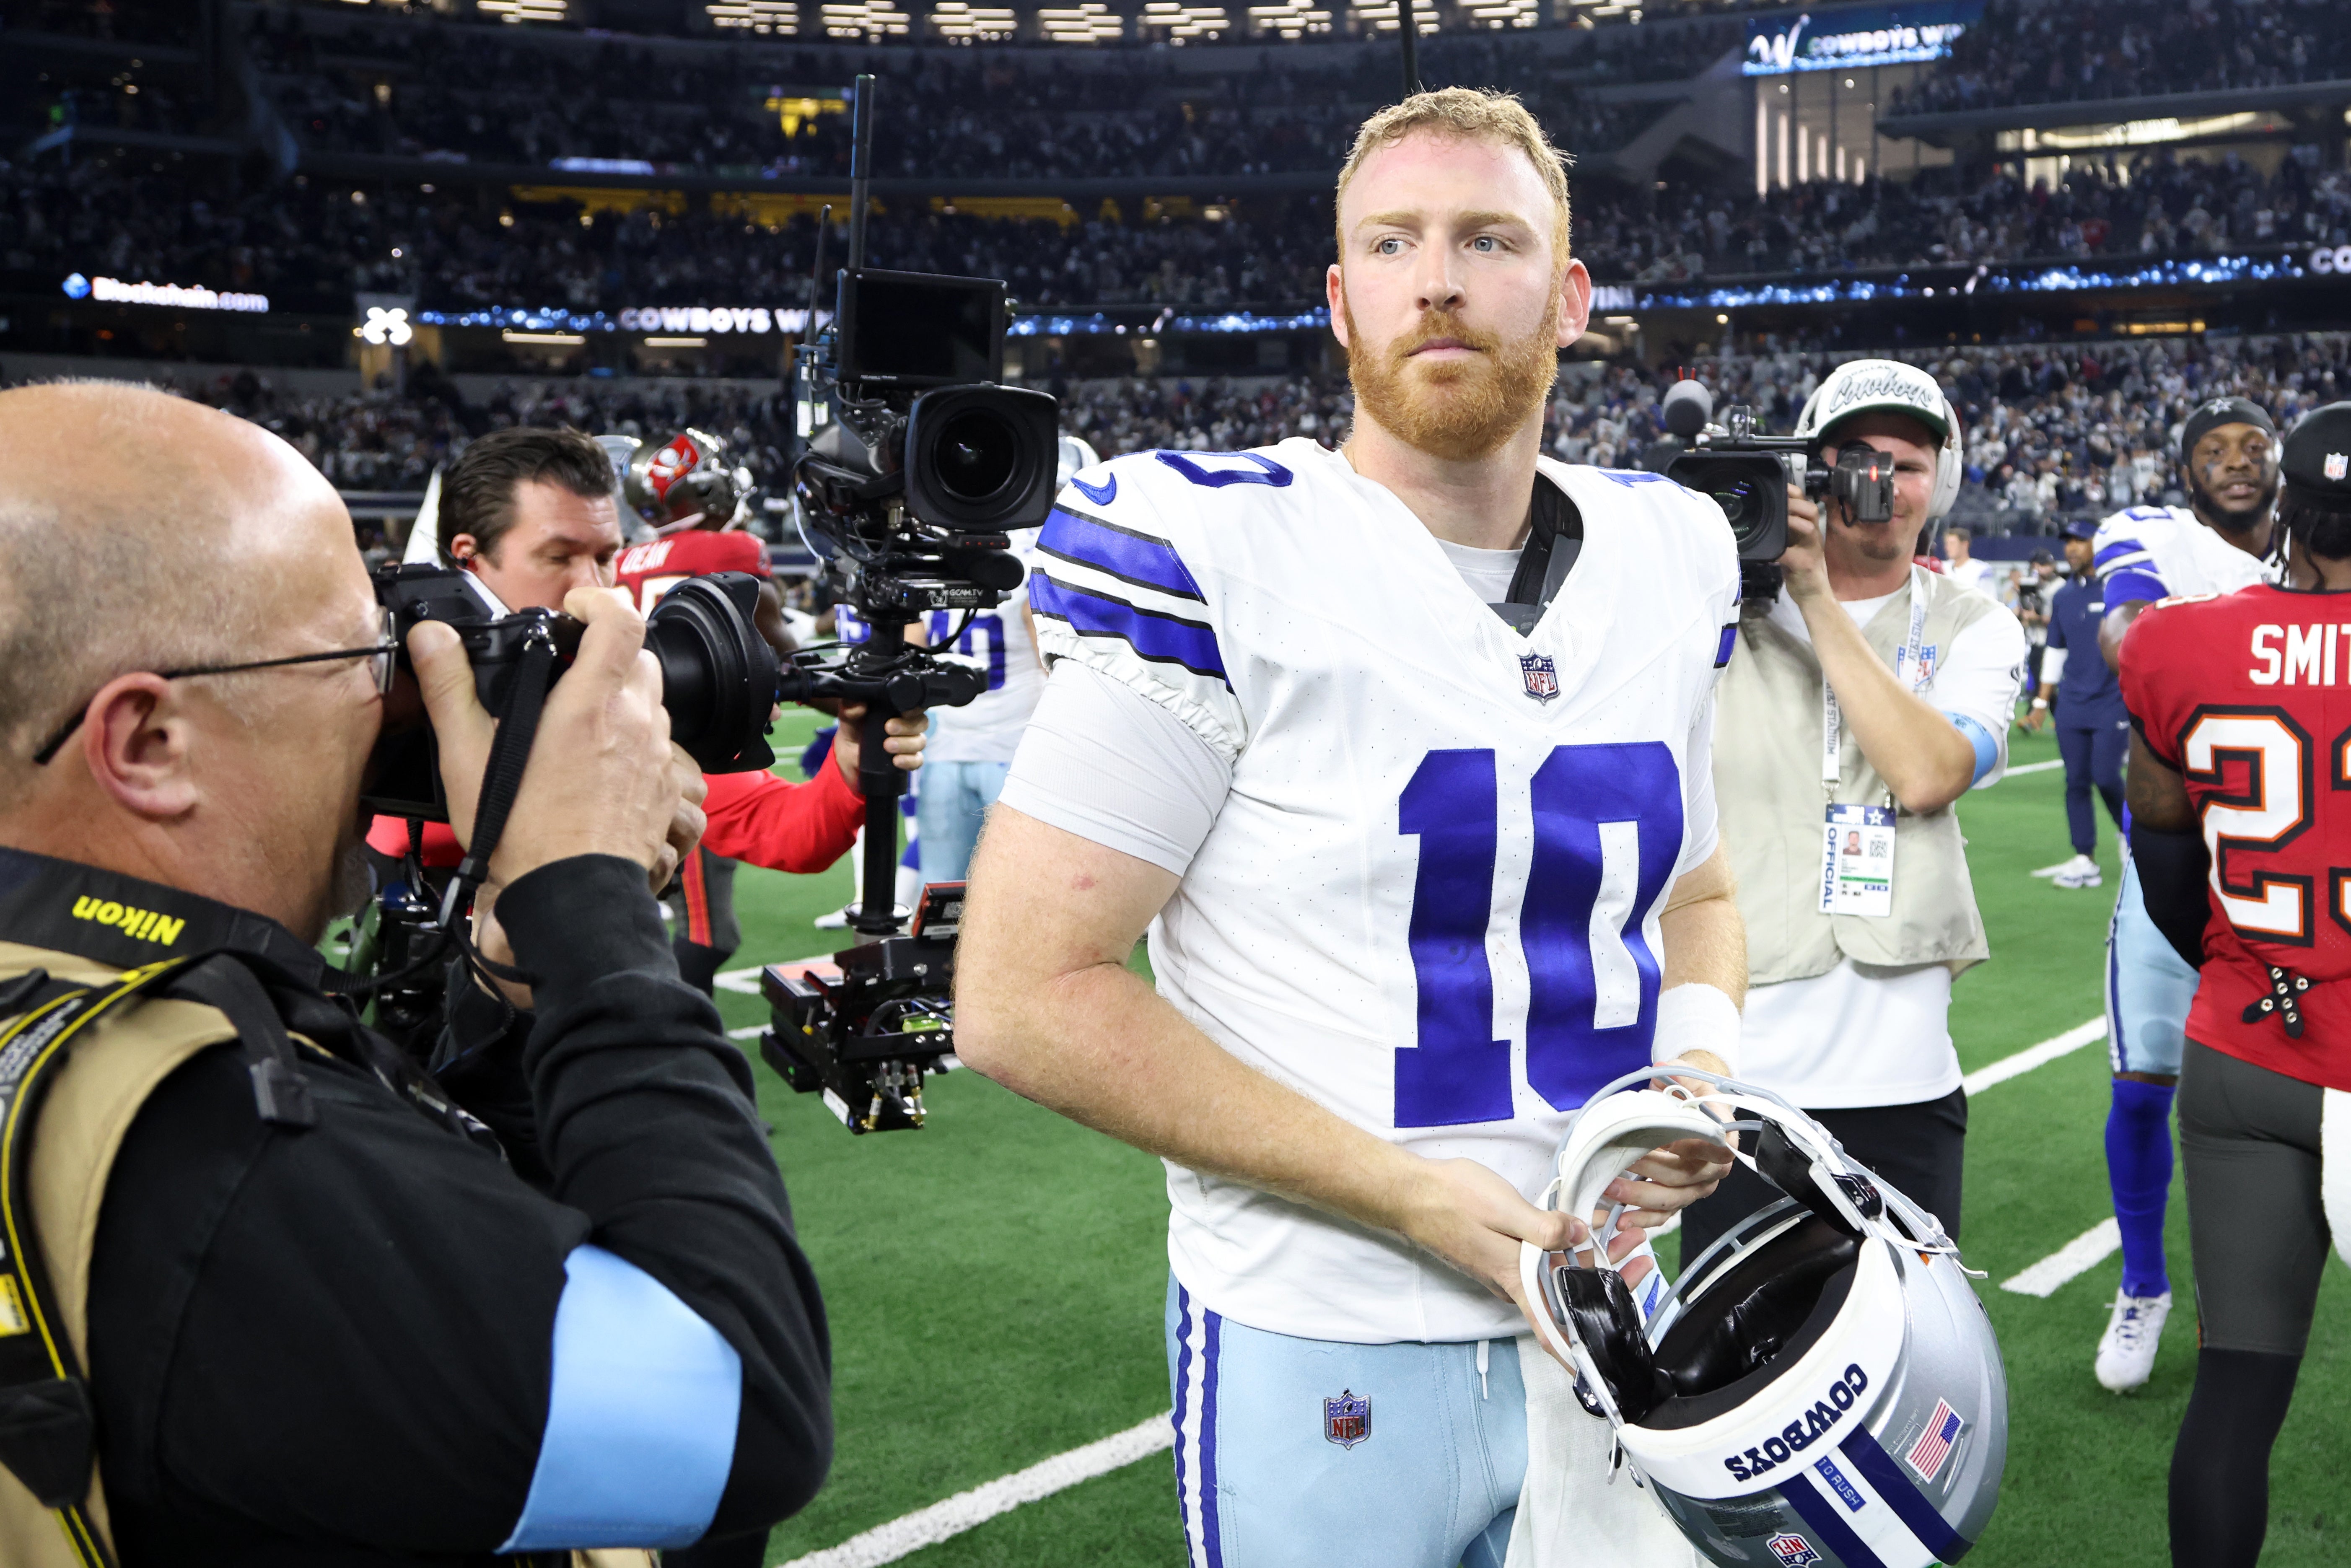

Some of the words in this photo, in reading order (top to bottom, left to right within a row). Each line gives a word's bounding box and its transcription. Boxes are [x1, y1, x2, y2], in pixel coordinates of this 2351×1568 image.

[619, 306, 772, 334] COWBOYS
[2328, 464, 2345, 477] NFL
[620, 540, 675, 574] DEAN
[1912, 602, 1922, 636] STADIUM
[1908, 637, 1919, 661] AT&T
[1527, 673, 1555, 694] NFL
[1827, 710, 1838, 754] STADIUM
[2177, 704, 2351, 948] 2
[1823, 827, 1837, 908] OFFICIAL
[72, 895, 185, 946] Nikon
[1394, 741, 1684, 1128] 10
[1332, 1416, 1364, 1439] NFL
[1724, 1363, 1868, 1482] COWBOYS
[1831, 1475, 1860, 1506] RUSH
[1772, 1539, 1806, 1555] NFL
